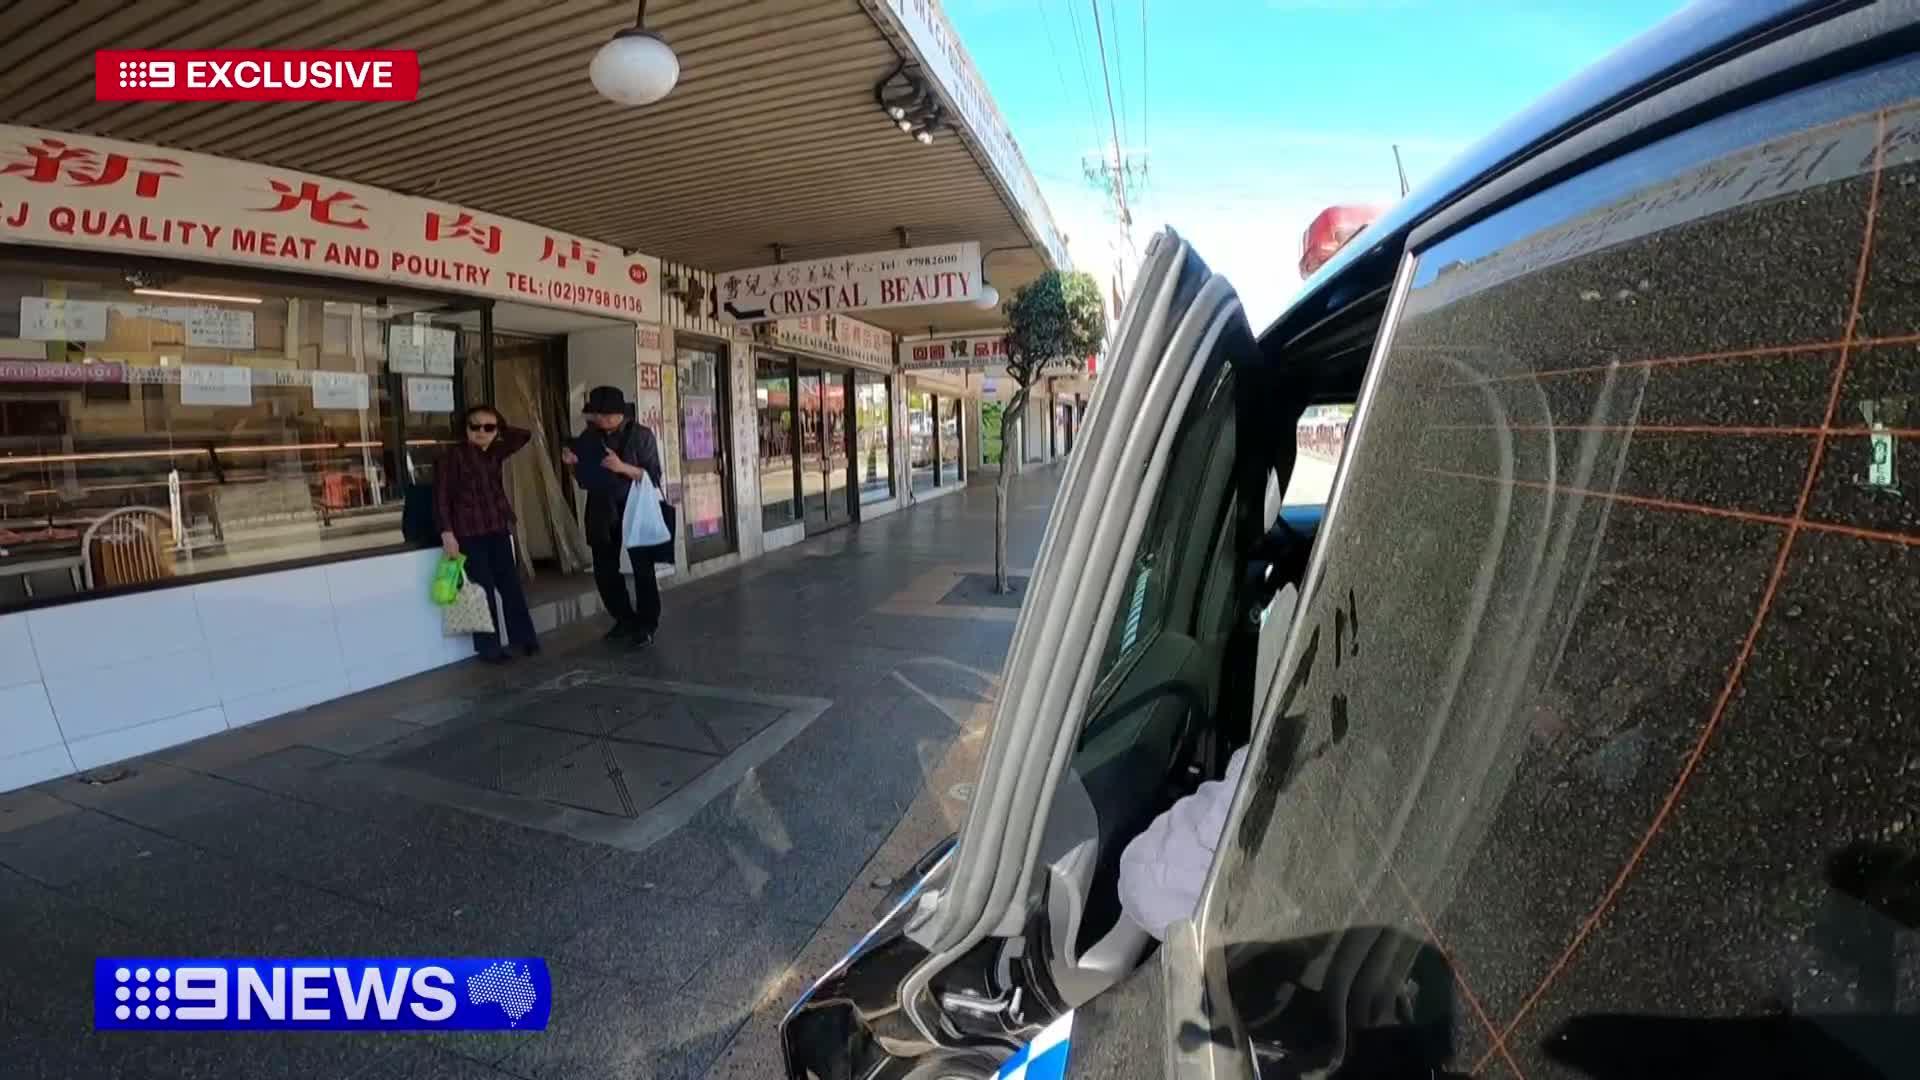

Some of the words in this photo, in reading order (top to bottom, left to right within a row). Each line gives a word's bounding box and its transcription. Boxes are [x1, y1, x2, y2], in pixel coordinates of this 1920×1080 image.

[49, 206, 223, 249] QUALITY
[232, 228, 318, 260] MEAT
[324, 242, 380, 271] AND
[391, 251, 491, 287] POULTRY
[768, 281, 868, 316] CRYSTAL
[880, 270, 972, 305] BEAUTY
